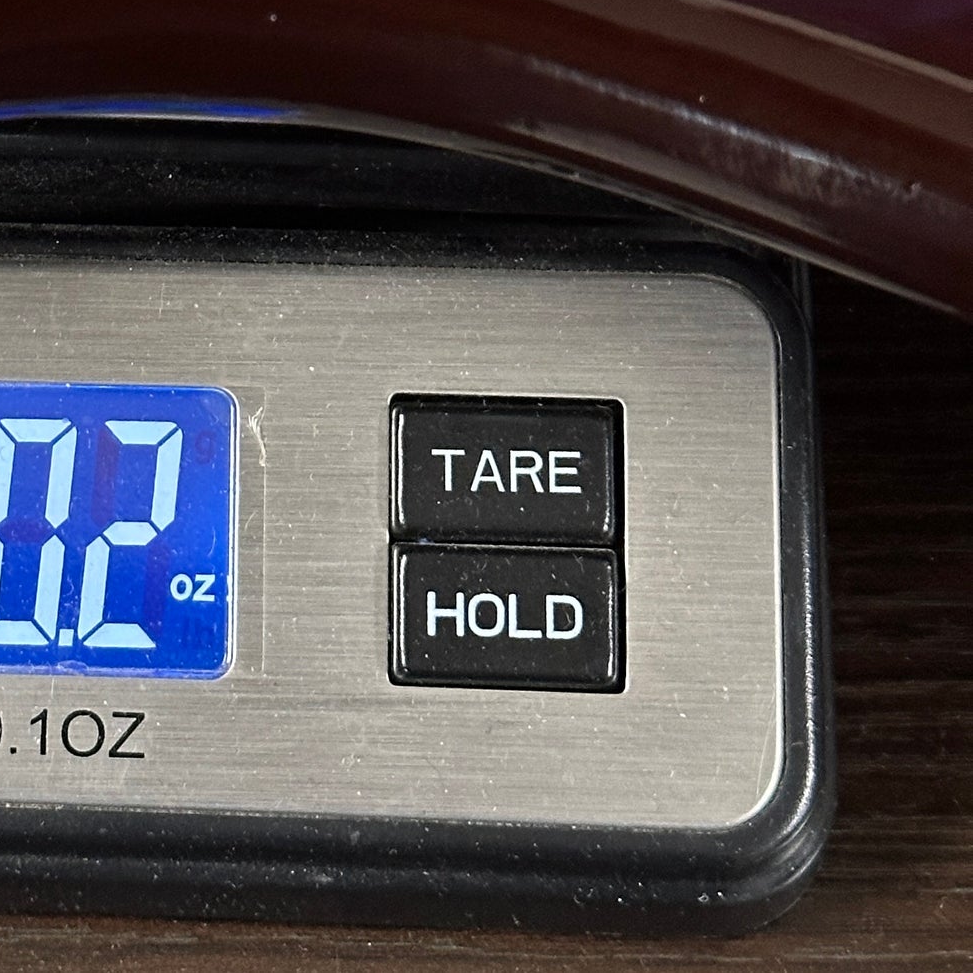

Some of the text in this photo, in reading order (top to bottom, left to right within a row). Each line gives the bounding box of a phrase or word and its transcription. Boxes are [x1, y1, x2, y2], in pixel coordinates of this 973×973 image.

[431, 449, 582, 494] TARE
[169, 573, 216, 602] oz
[427, 591, 583, 639] HOLD
